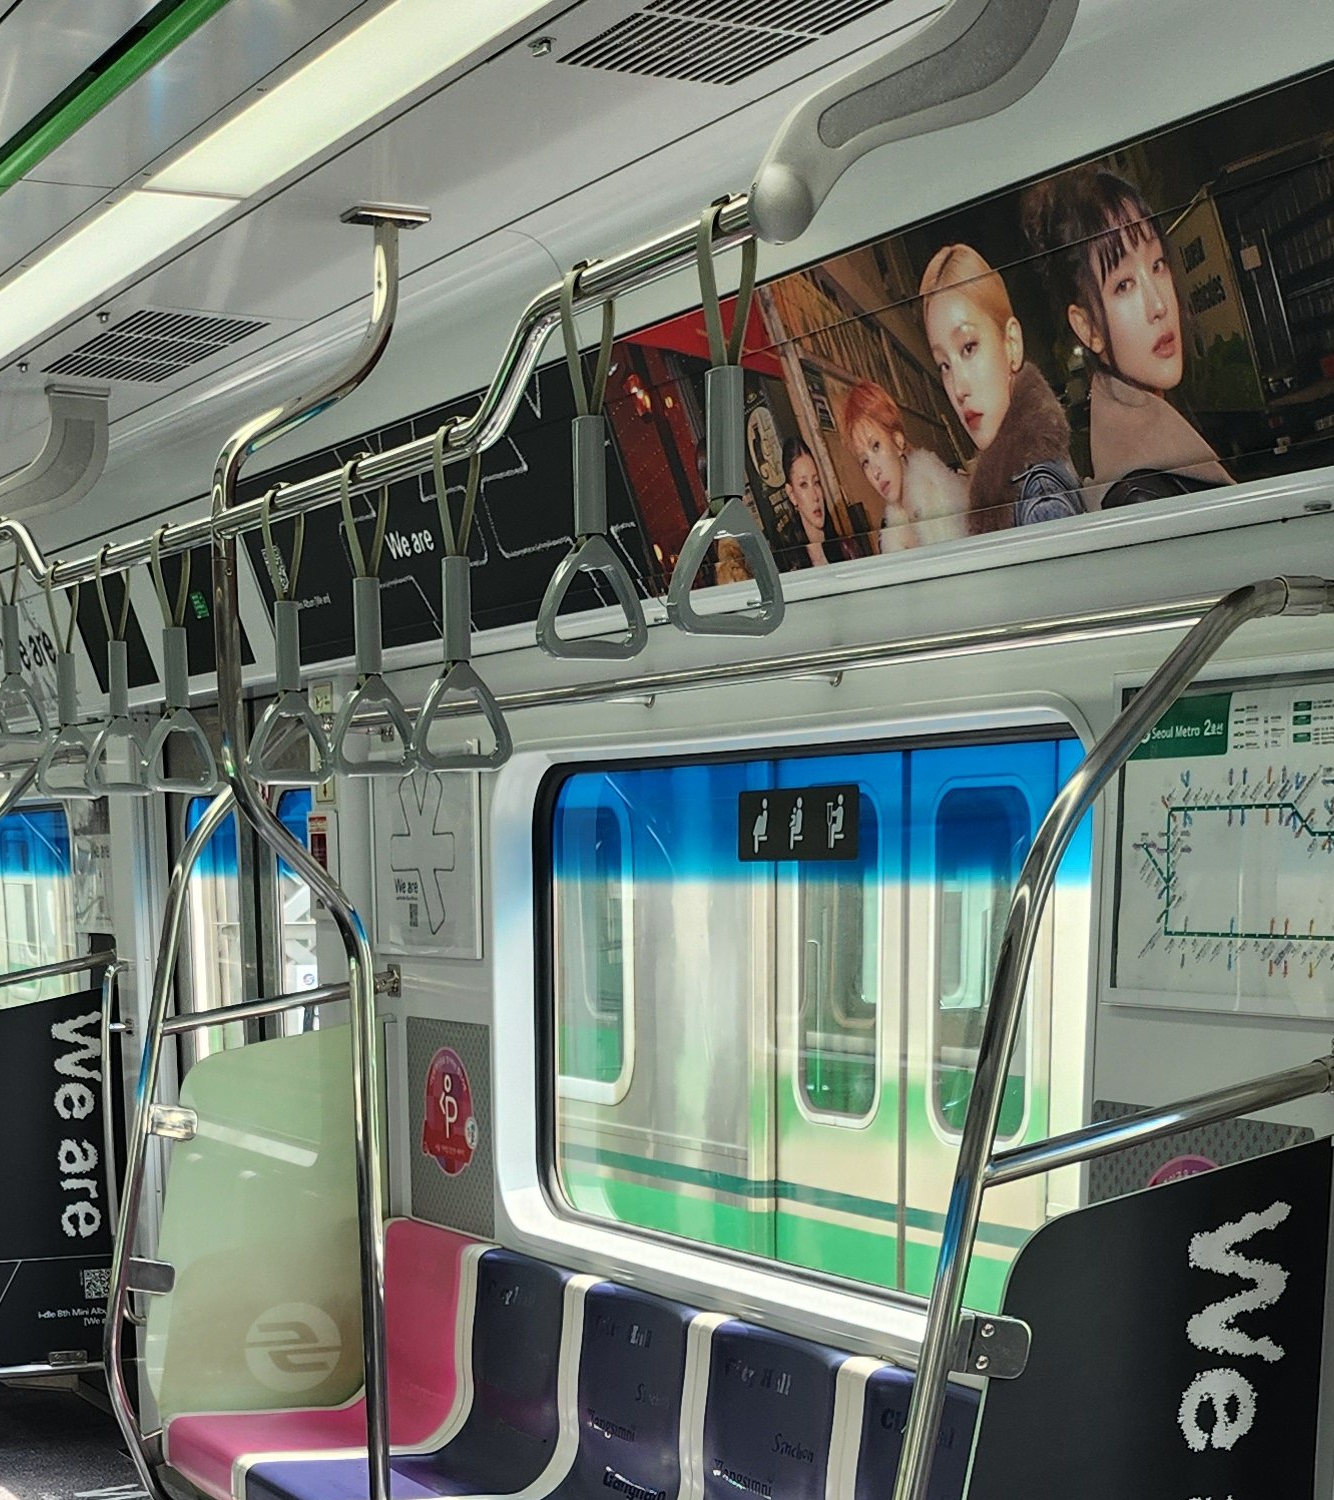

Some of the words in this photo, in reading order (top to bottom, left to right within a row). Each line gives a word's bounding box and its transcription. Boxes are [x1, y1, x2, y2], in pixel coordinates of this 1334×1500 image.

[385, 530, 411, 560] We
[412, 528, 435, 552] are
[1151, 729, 1173, 740] Seoul
[1174, 727, 1200, 738] Metro
[394, 878, 407, 895] We
[407, 877, 419, 895] are
[51, 1009, 103, 1120] We
[57, 1137, 102, 1239] are
[1174, 1199, 1293, 1453] We
